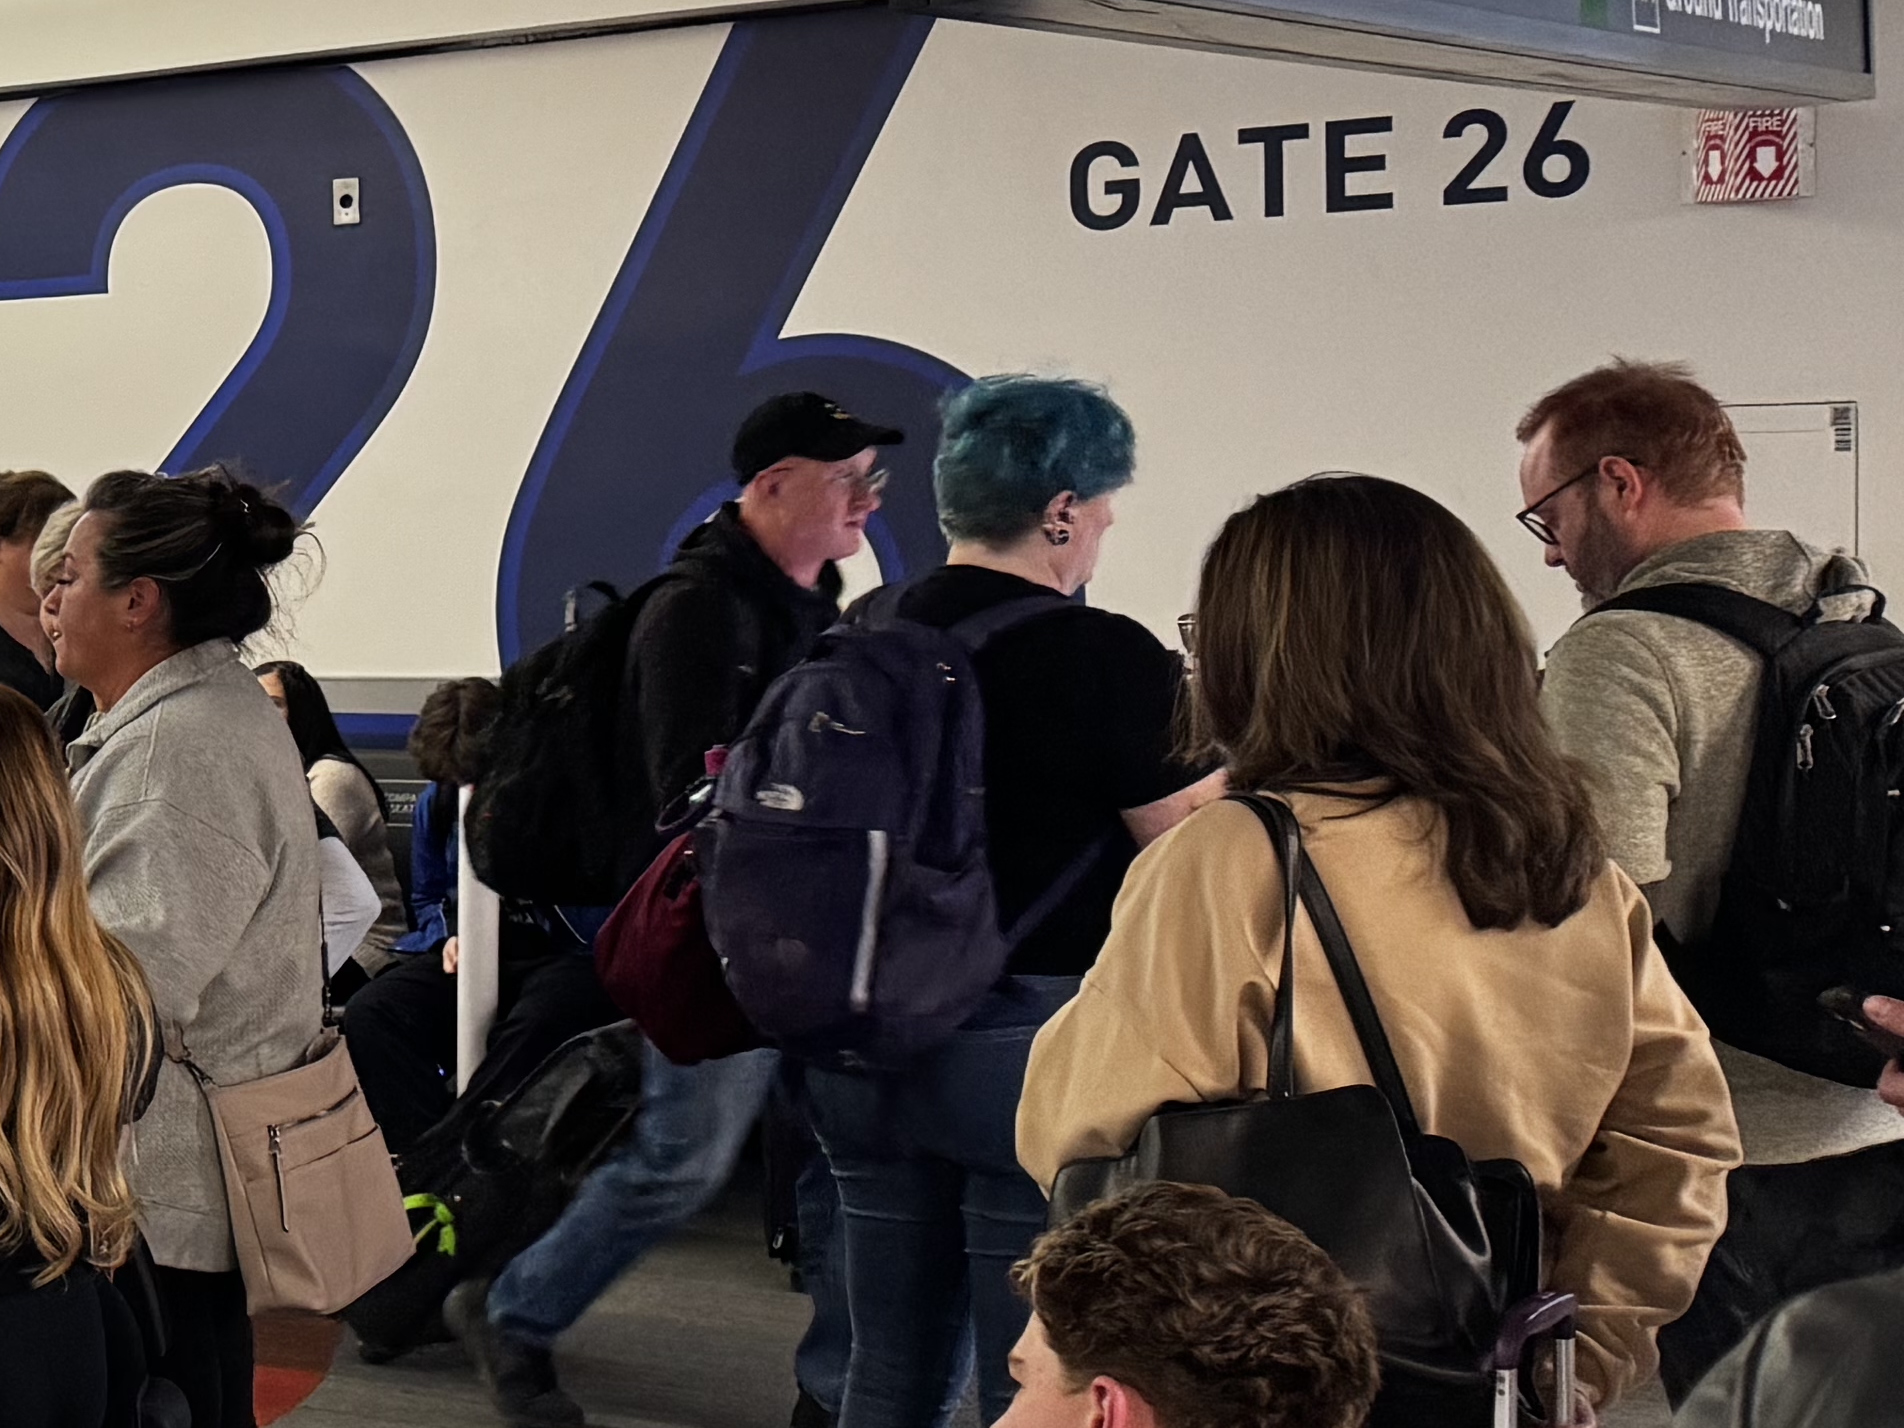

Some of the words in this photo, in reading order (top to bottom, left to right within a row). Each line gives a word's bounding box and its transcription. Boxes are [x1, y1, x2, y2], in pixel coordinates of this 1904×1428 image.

[1748, 116, 1783, 132] FIRE
[1069, 115, 1393, 232] GATE
[1442, 100, 1591, 206] 26
